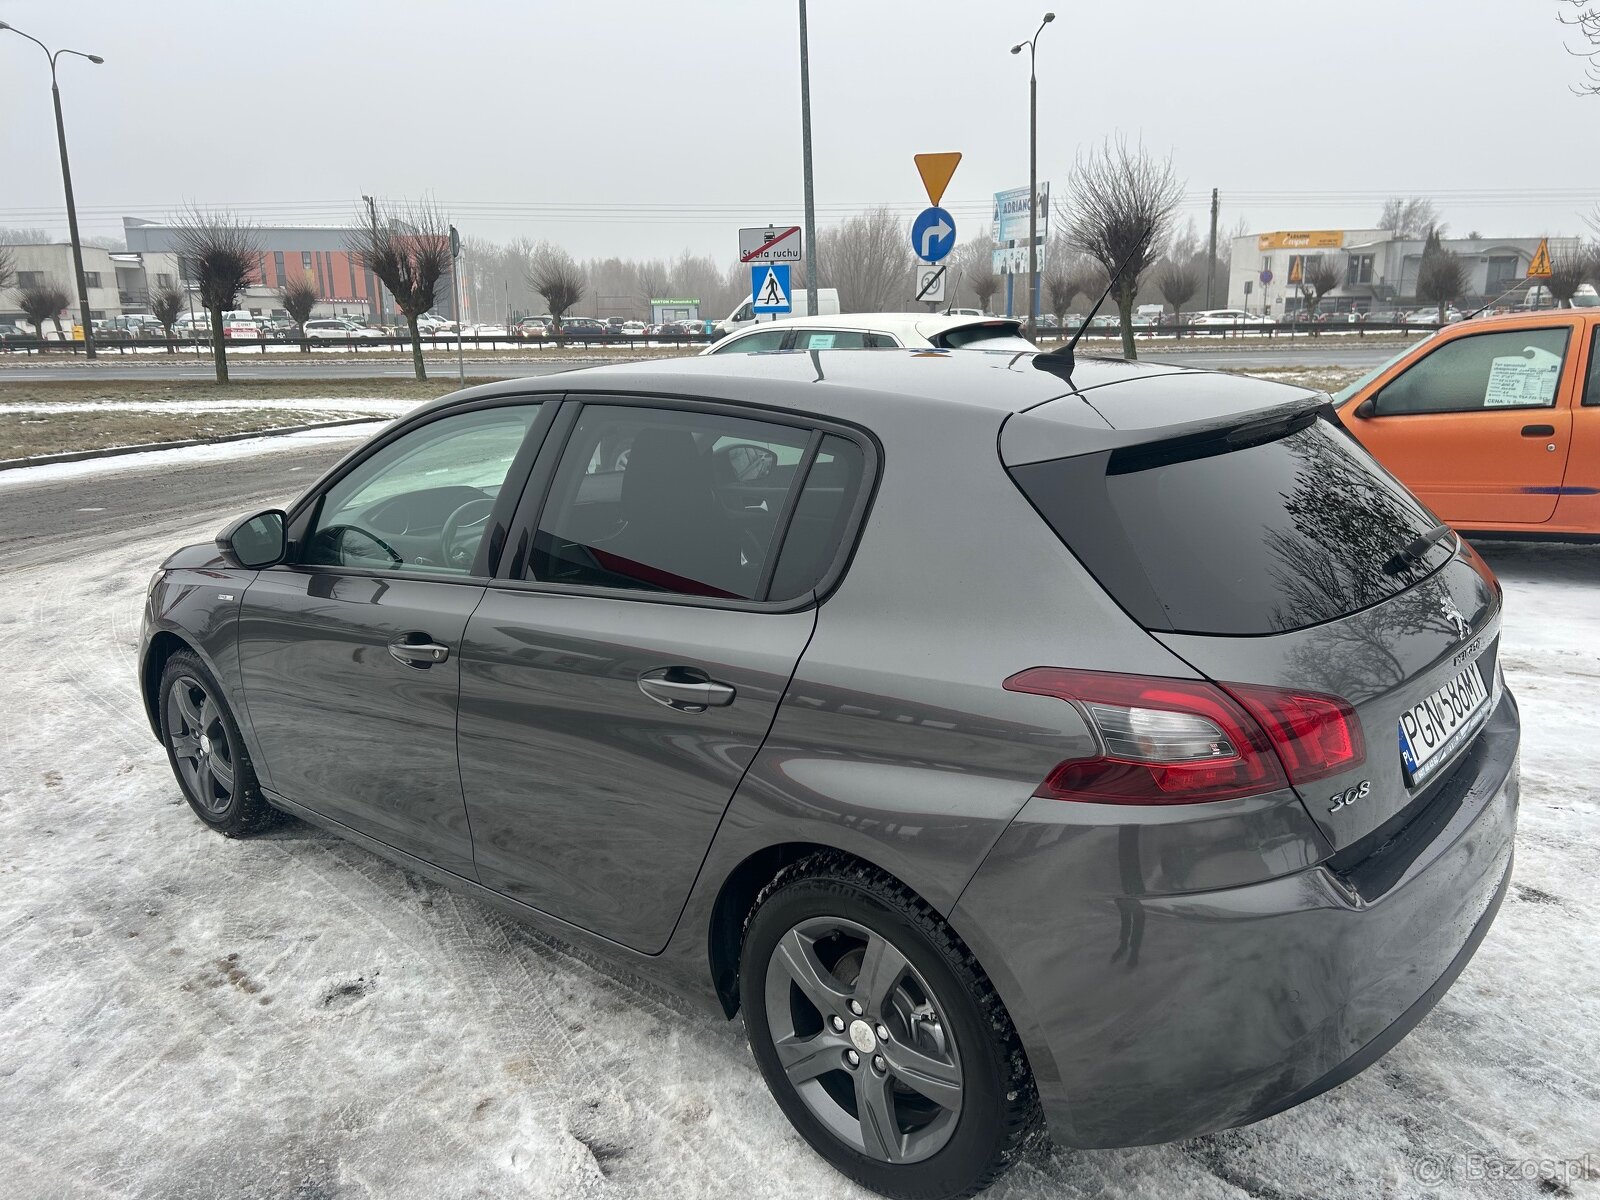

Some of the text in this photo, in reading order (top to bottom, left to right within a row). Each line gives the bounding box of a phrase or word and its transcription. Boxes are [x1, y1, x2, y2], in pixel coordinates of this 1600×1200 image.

[742, 248, 798, 259] Stfa ruchu
[1401, 663, 1483, 761] PGN 586MY
[1403, 749, 1413, 765] PL
[1328, 780, 1370, 812] 308
